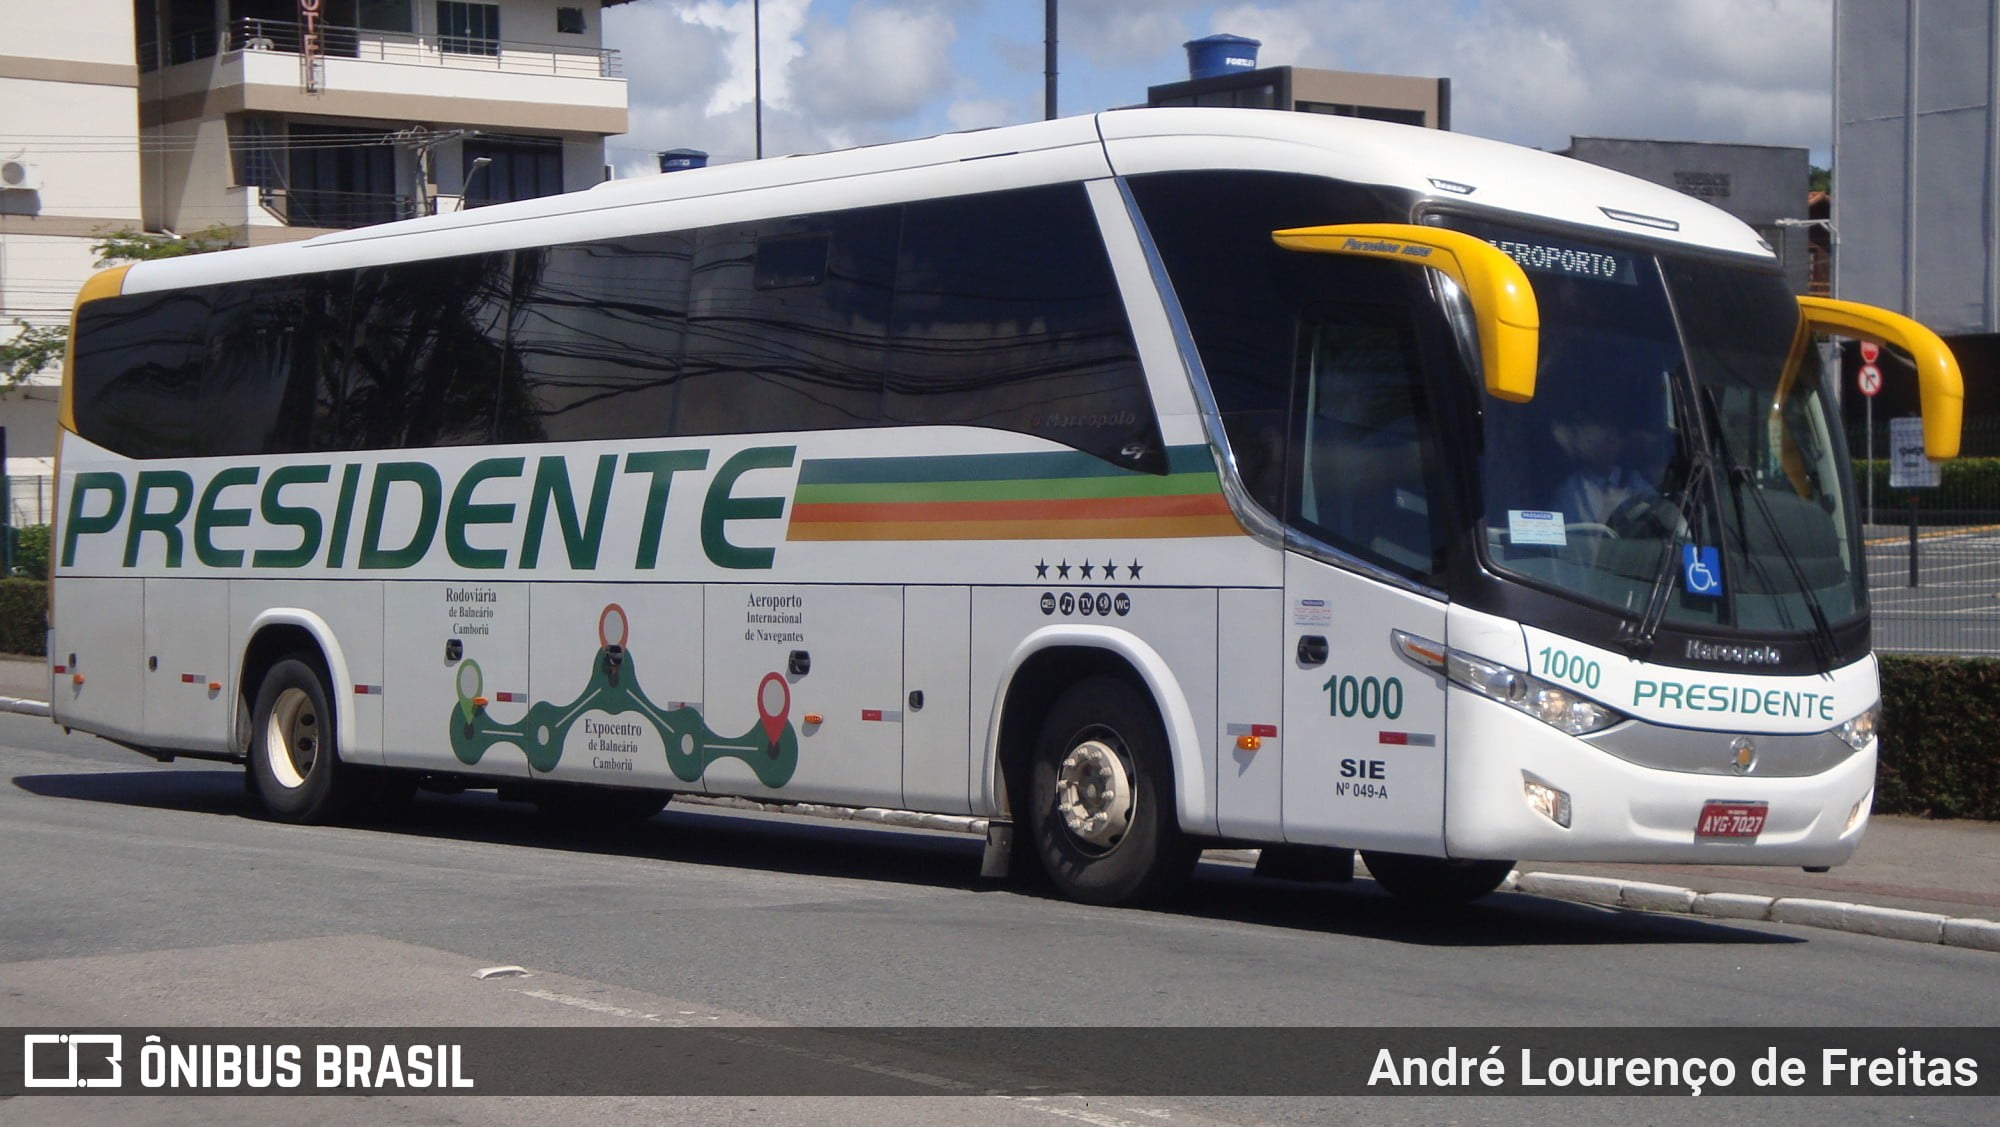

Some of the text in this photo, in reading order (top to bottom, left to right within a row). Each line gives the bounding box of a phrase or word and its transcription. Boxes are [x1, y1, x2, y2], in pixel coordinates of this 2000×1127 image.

[1489, 239, 1617, 277] EROPORTO
[61, 446, 796, 570] PRESIDENTE
[446, 587, 497, 603] Rodoviária
[747, 592, 802, 612] Aeroporto
[1081, 597, 1093, 609] TV
[448, 606, 494, 618] de Balneário
[1115, 599, 1130, 610] WC
[747, 611, 802, 624] Internacional
[453, 622, 489, 635] Camboriú
[745, 628, 804, 645] de Navegantes
[1540, 647, 1601, 689] 1000
[1323, 675, 1403, 720] 1000
[1633, 680, 1834, 721] PRESIDENTE
[585, 719, 642, 738] Expocentro
[588, 739, 638, 753] de Balneário
[592, 757, 633, 771] Camboriú
[1340, 758, 1385, 780] SIE
[1353, 783, 1388, 800] 049-A
